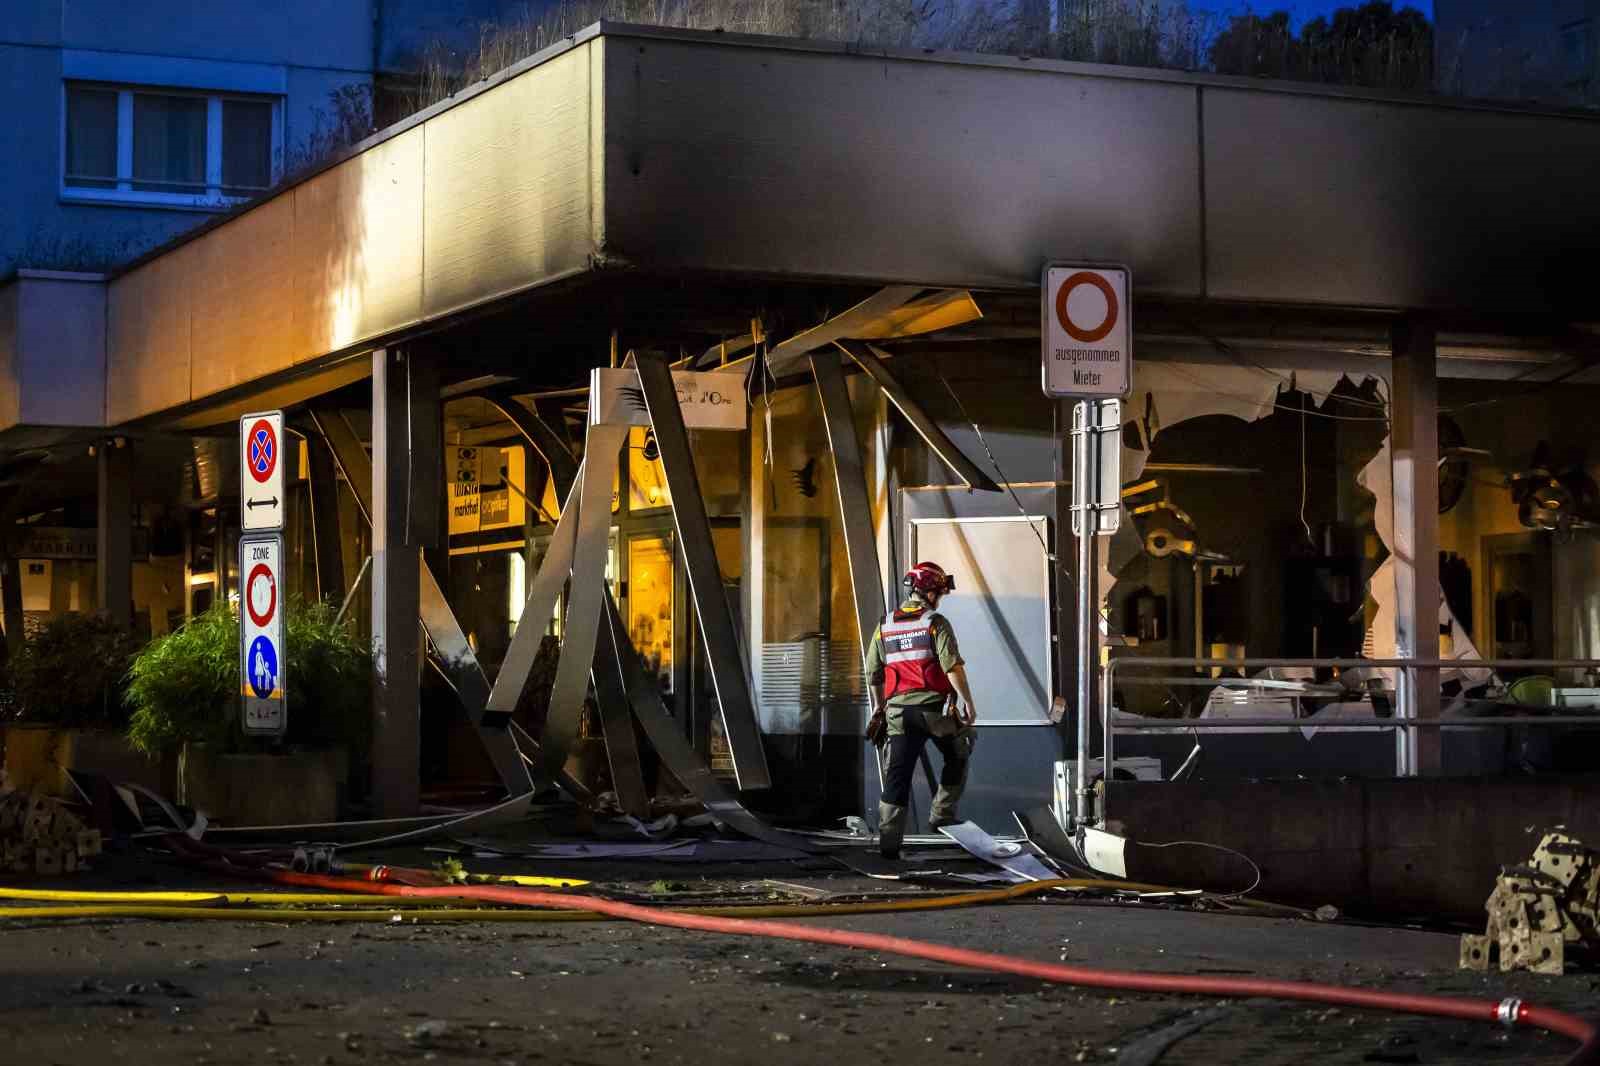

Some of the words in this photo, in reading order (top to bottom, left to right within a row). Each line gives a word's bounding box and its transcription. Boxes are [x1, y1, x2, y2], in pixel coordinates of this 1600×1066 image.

[1055, 348, 1120, 365] ausgenommen
[1073, 369, 1102, 386] Mieter
[252, 546, 270, 560] ZONE
